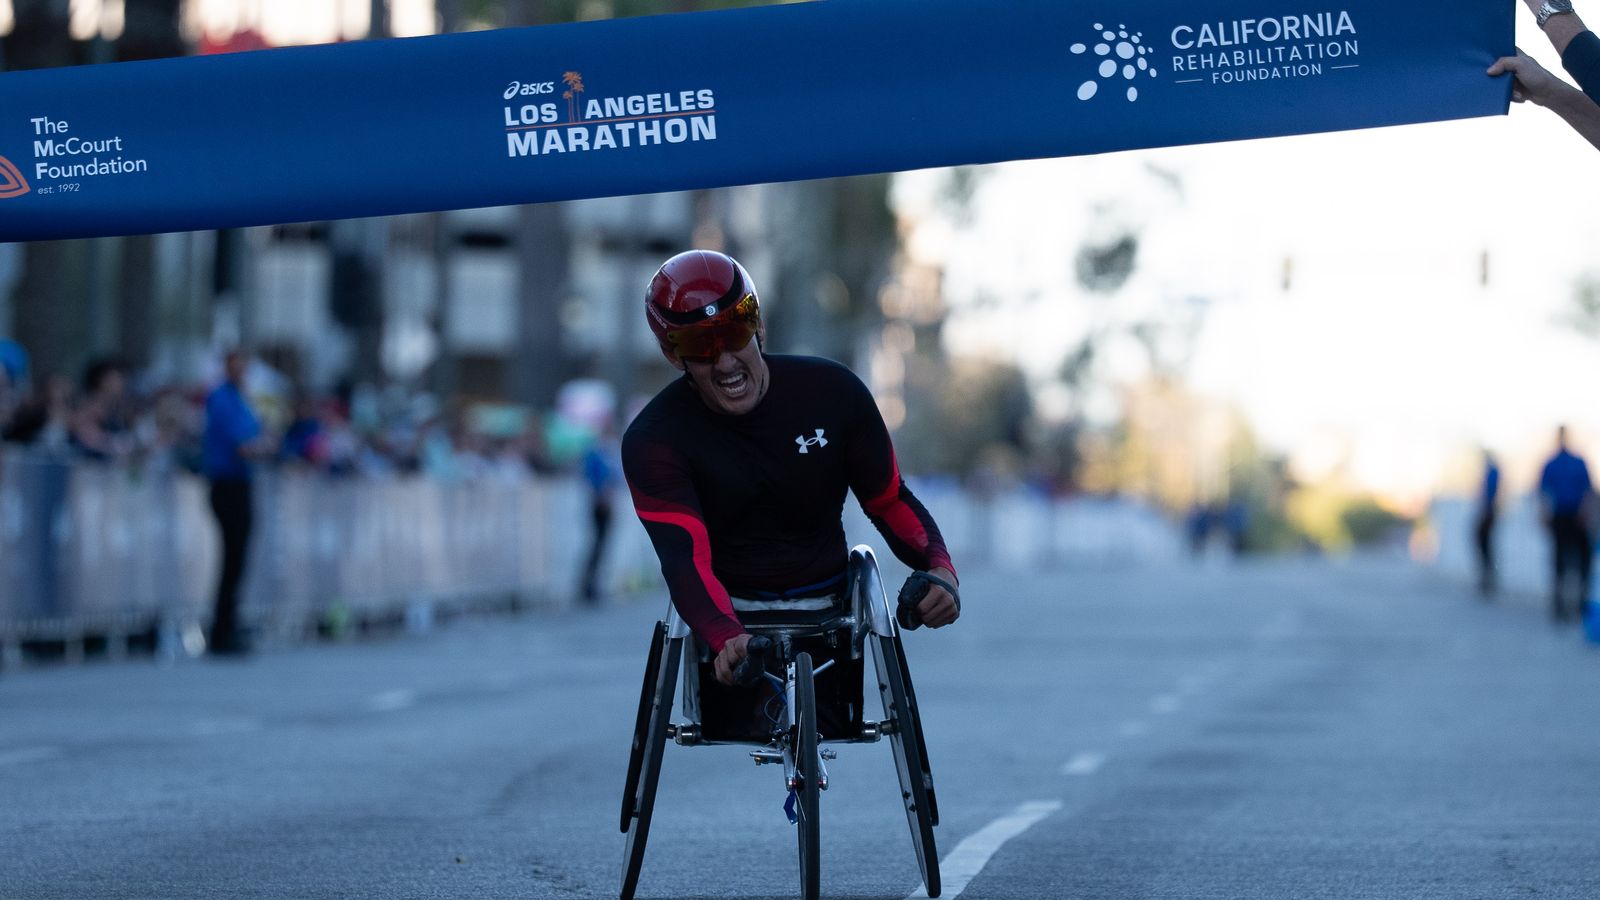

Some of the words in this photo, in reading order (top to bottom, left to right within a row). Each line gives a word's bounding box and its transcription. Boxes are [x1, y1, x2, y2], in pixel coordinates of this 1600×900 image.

[1171, 10, 1356, 50] CALIFORNIA
[1172, 40, 1359, 72] REHABILITATION
[1212, 63, 1322, 85] FOUNDATION
[504, 103, 559, 127] LOS
[585, 89, 715, 119] ANGELES
[30, 116, 69, 135] The
[506, 115, 717, 158] MARATHON
[33, 136, 122, 158] McCourt
[35, 156, 147, 180] Foundation
[37, 186, 54, 195] est.
[58, 183, 80, 193] 1992
